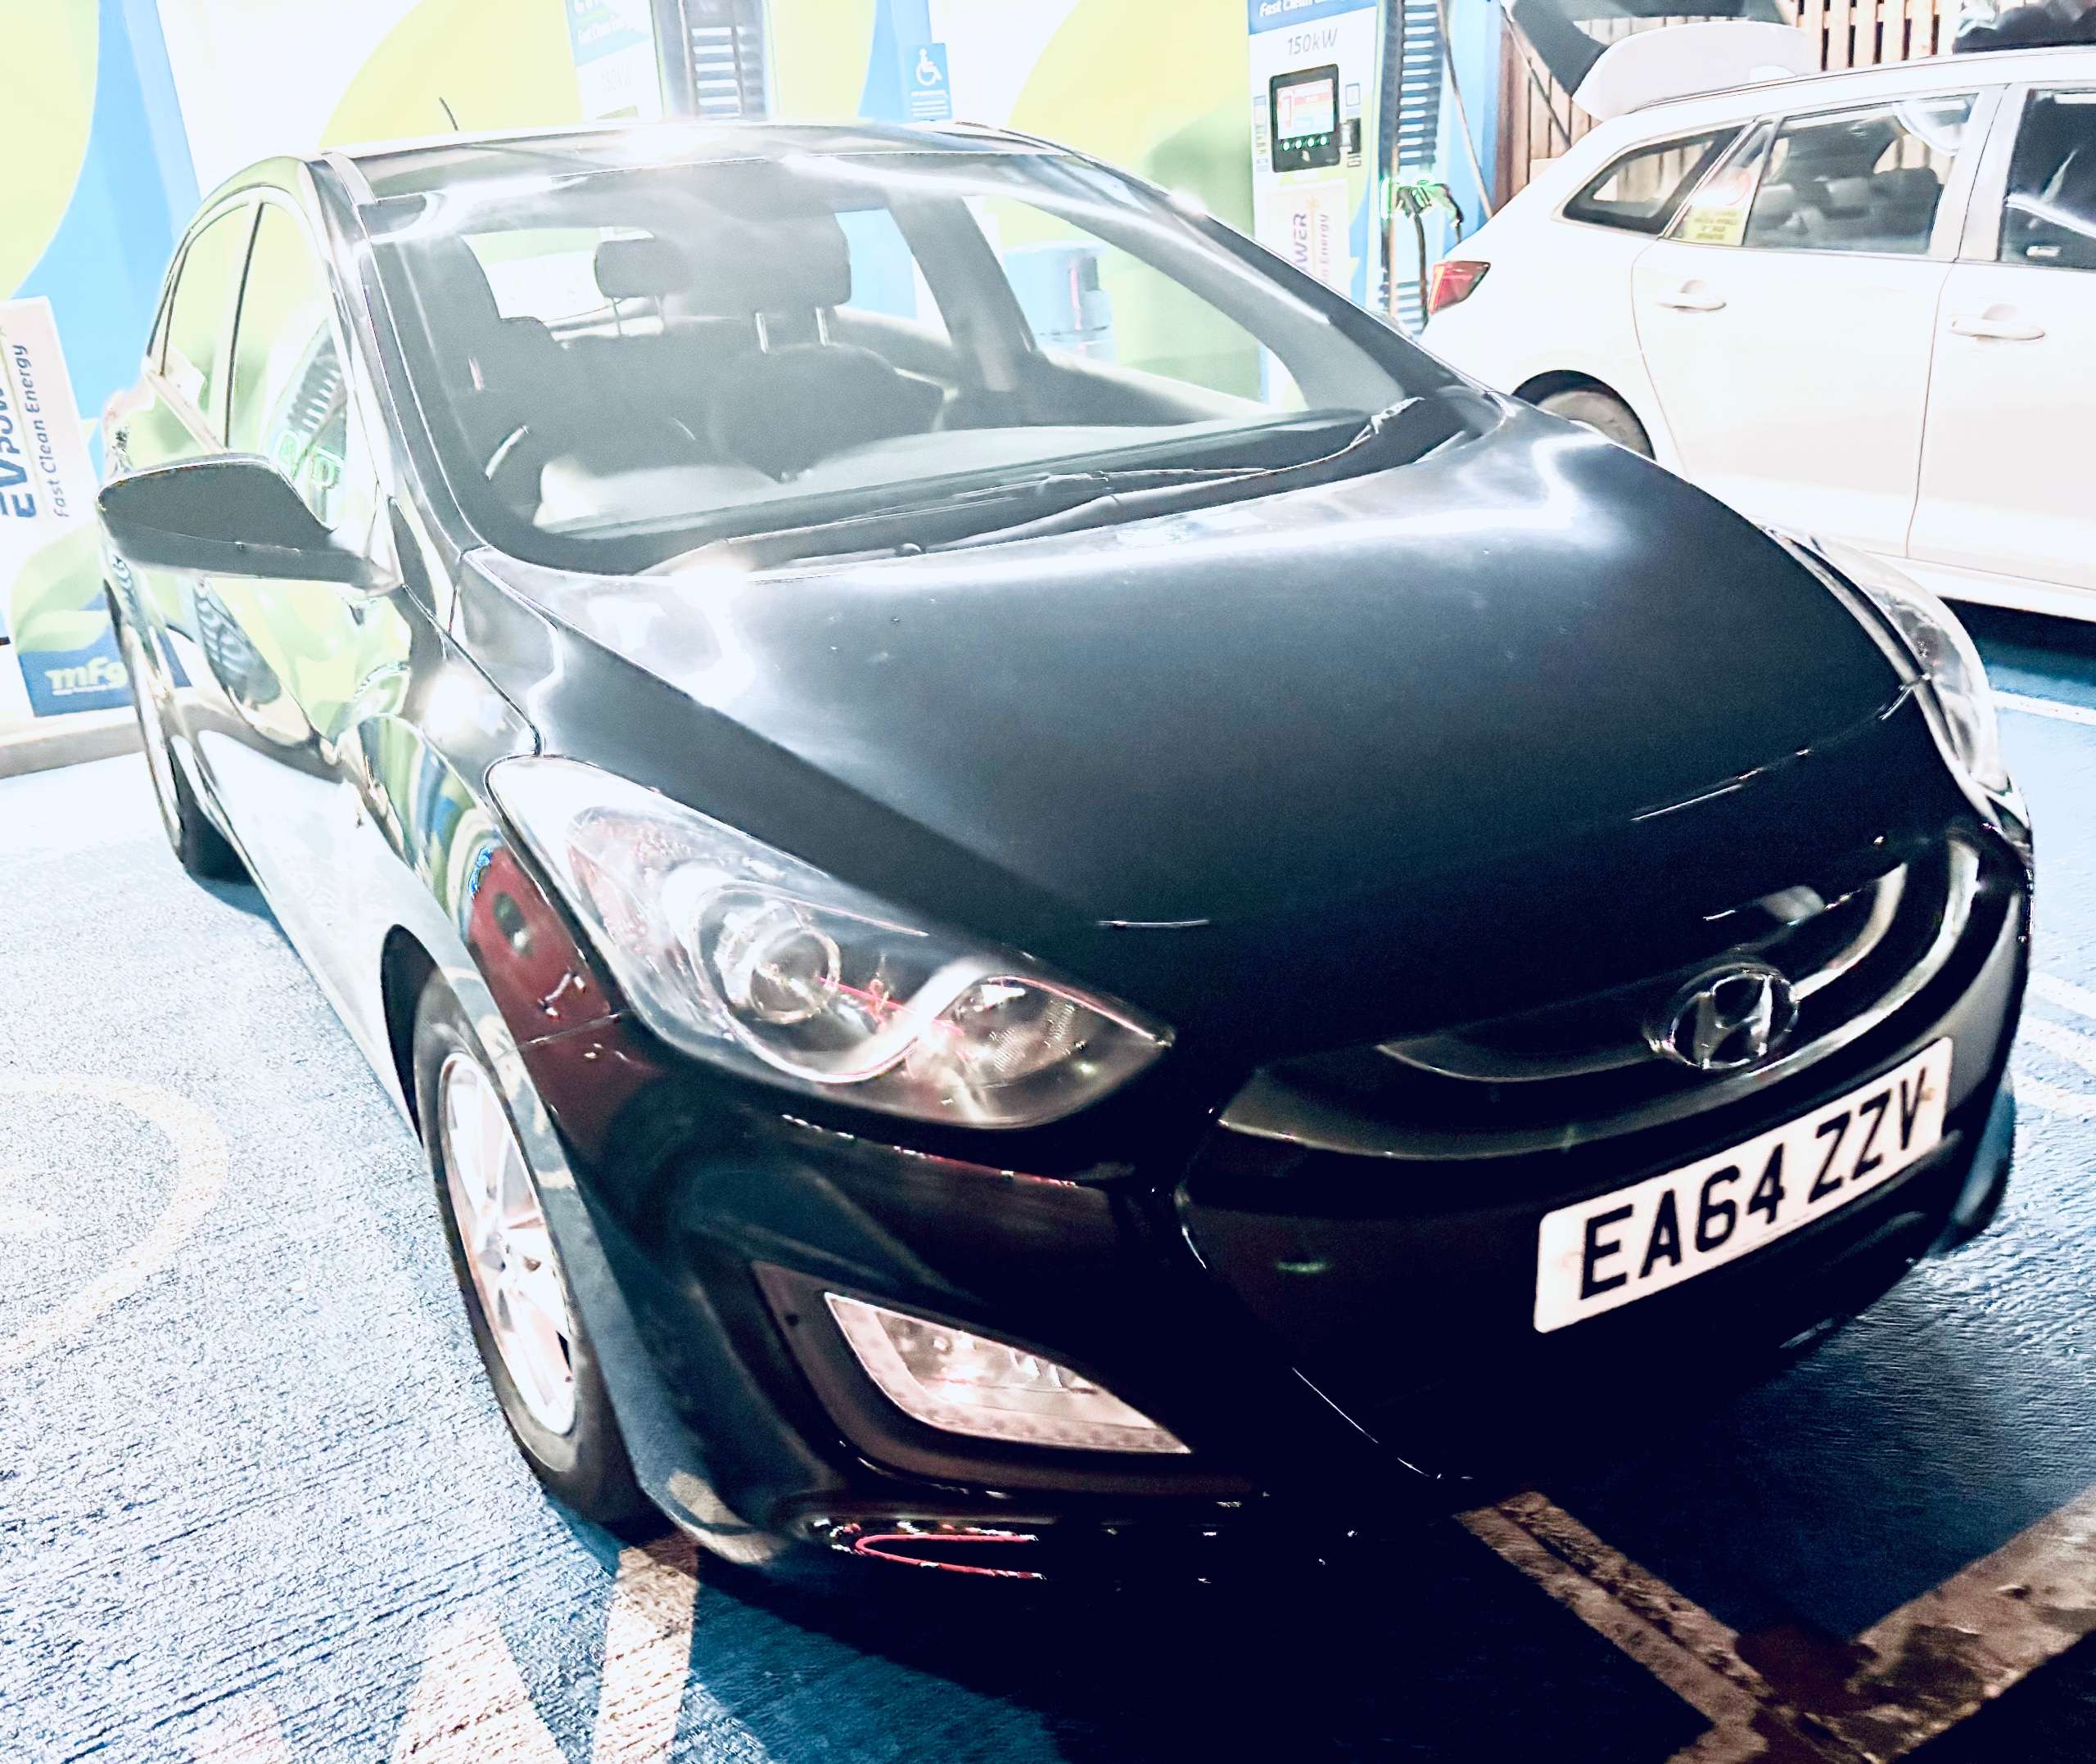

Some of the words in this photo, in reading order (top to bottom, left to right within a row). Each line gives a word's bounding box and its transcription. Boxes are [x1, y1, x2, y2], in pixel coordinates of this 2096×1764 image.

[1287, 27, 1339, 56] 150kW
[1293, 213, 1308, 271] WER
[12, 344, 41, 413] Energy
[32, 419, 57, 474] Clean
[47, 479, 70, 518] Fast
[45, 656, 129, 689] mfg
[1580, 1142, 1787, 1301] EA64
[1808, 1067, 1927, 1205] ZZV
